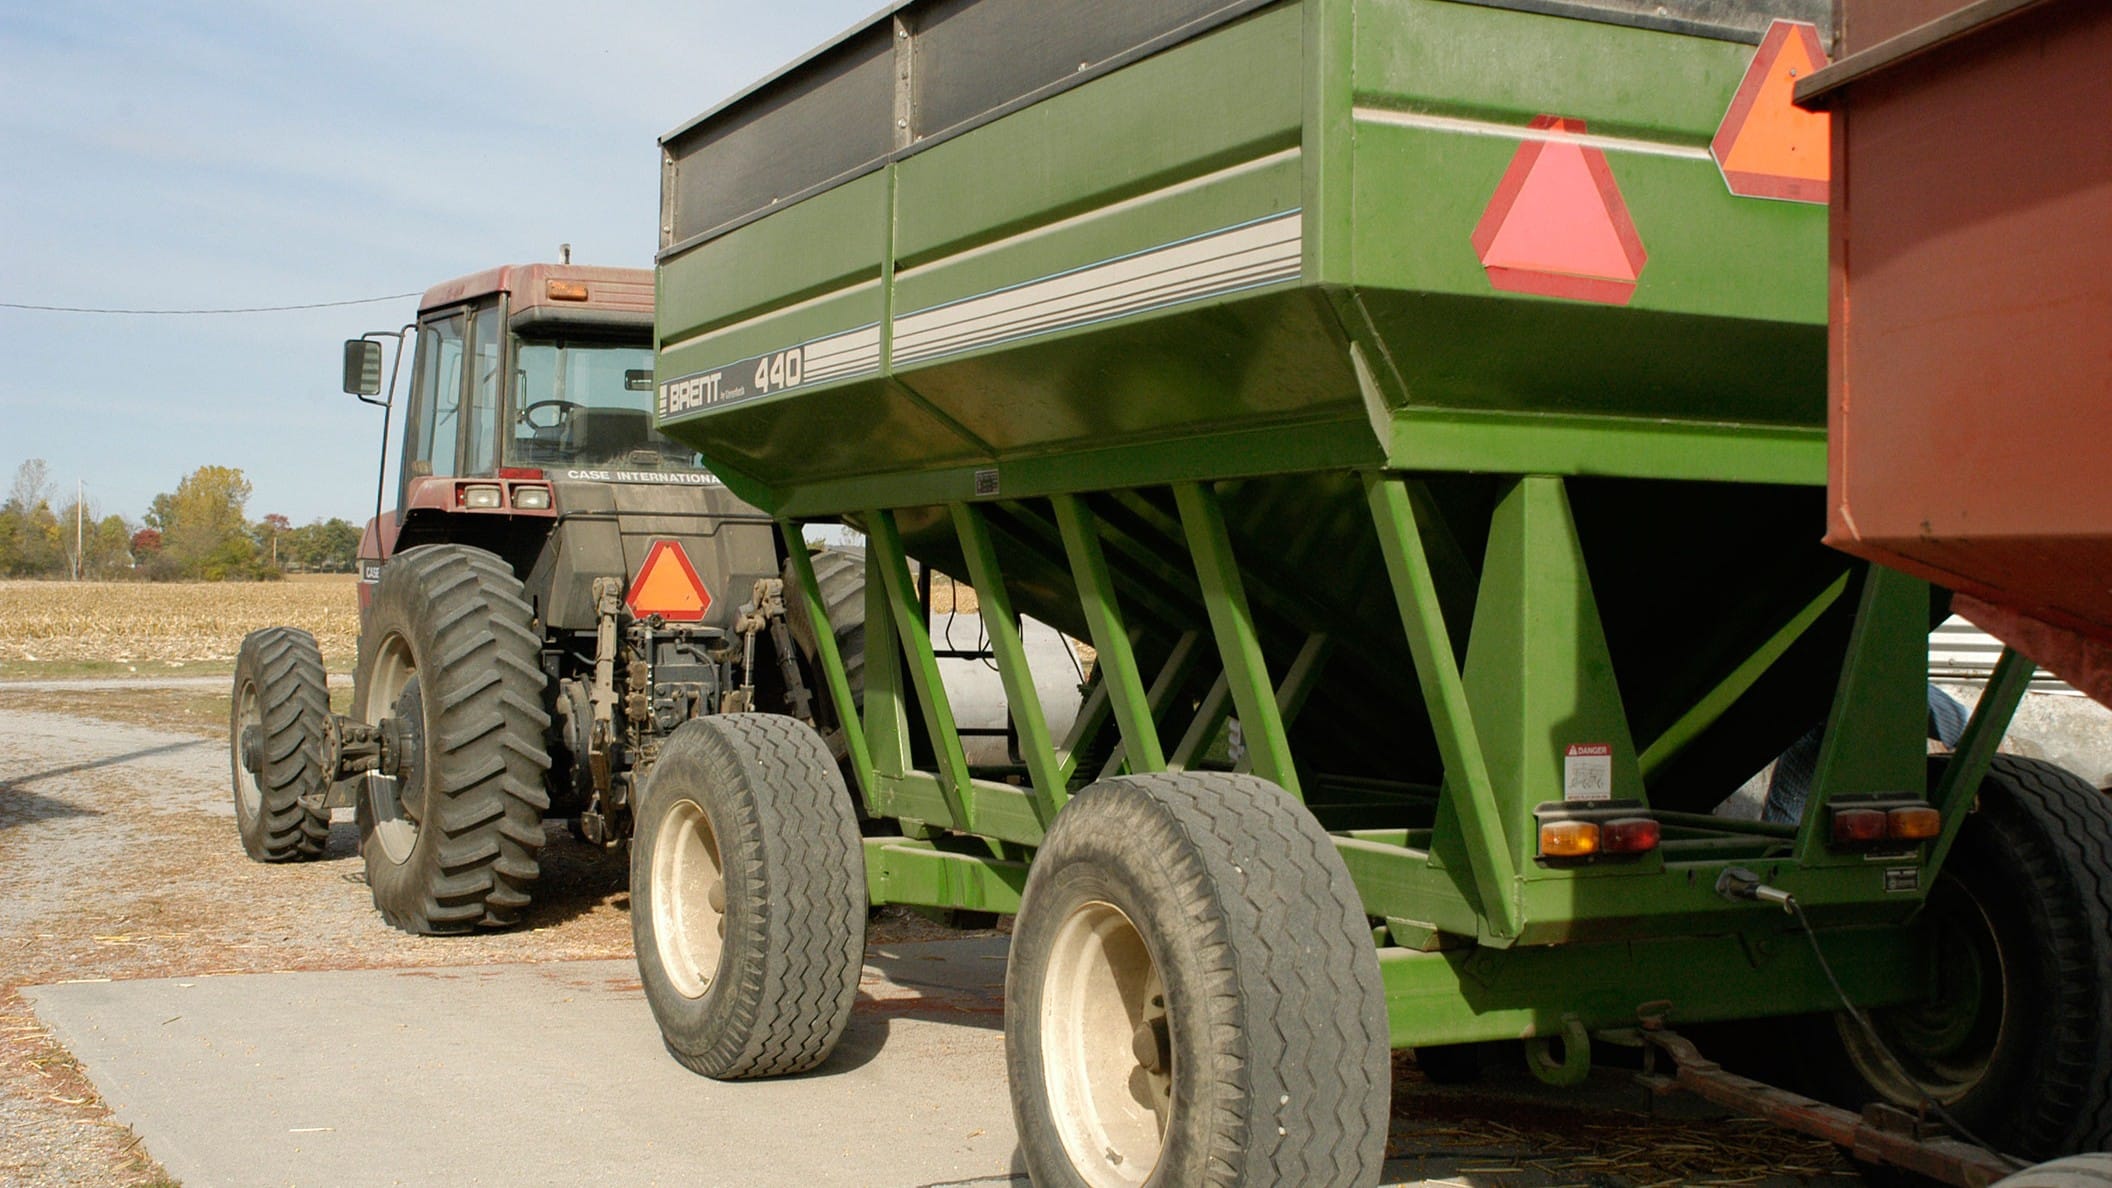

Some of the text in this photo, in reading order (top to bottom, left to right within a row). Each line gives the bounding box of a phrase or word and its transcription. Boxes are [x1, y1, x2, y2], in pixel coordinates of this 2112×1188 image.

[670, 371, 722, 413] BRENT
[755, 348, 802, 393] 440
[568, 470, 722, 484] CASE INTERNATIONA
[1577, 746, 1607, 754] DANGER
